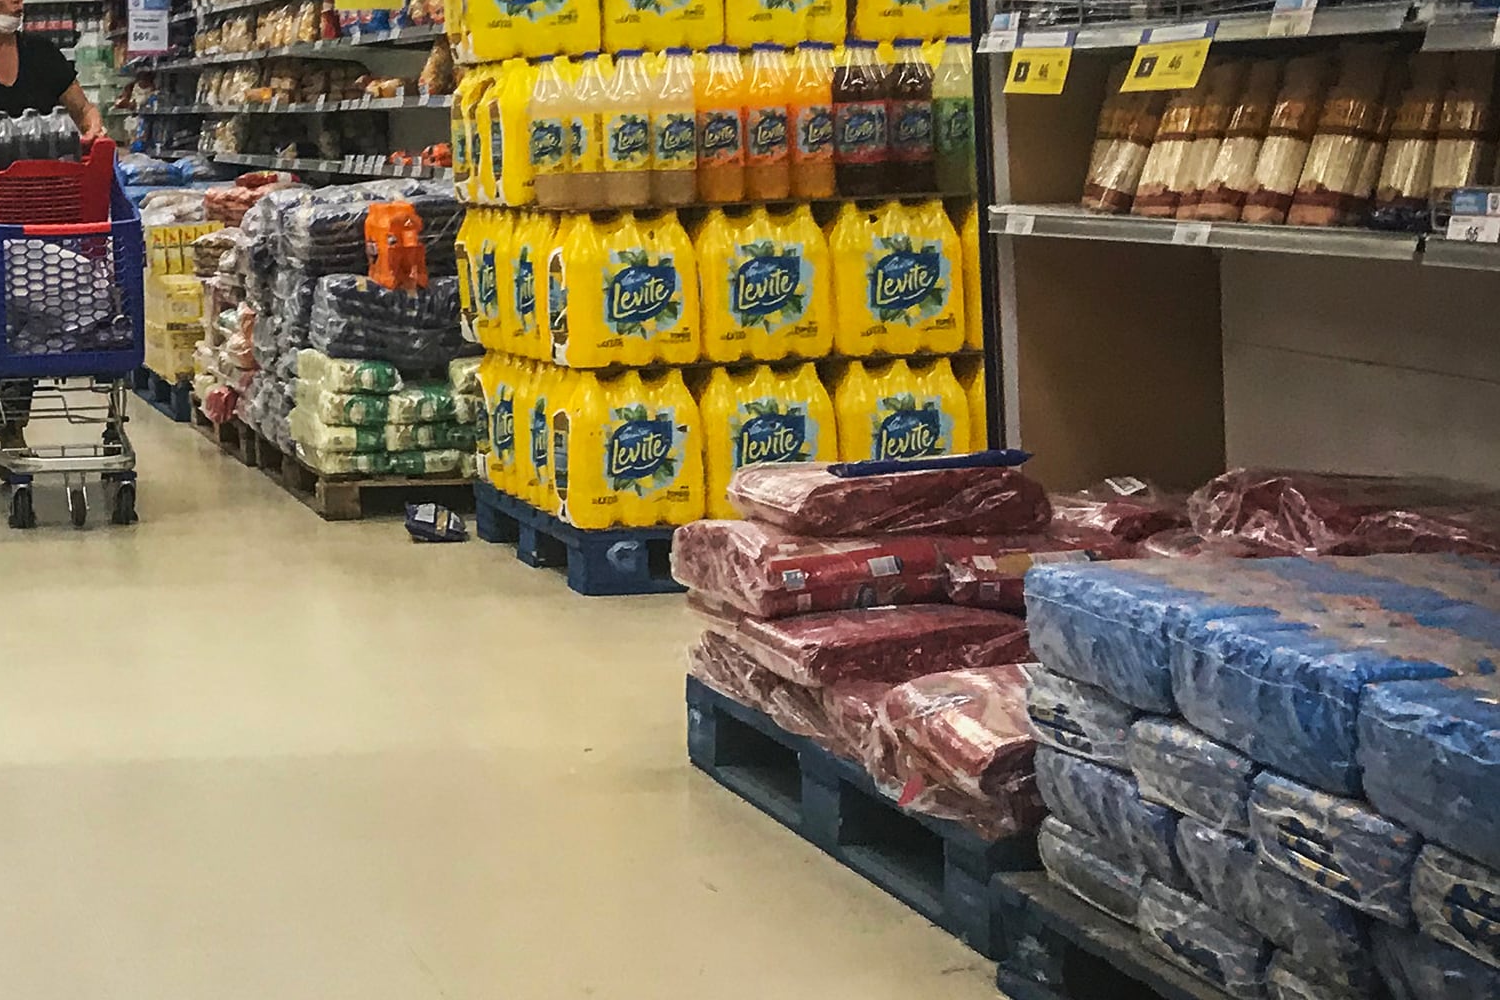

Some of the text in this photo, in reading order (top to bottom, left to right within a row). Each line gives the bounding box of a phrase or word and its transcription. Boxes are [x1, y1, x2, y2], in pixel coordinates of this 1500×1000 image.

[613, 276, 670, 319] Levite
[739, 268, 794, 310] Levite
[876, 263, 934, 305] Levite
[611, 432, 668, 475] Levite
[742, 426, 799, 465] Levite
[880, 422, 935, 462] Levite
